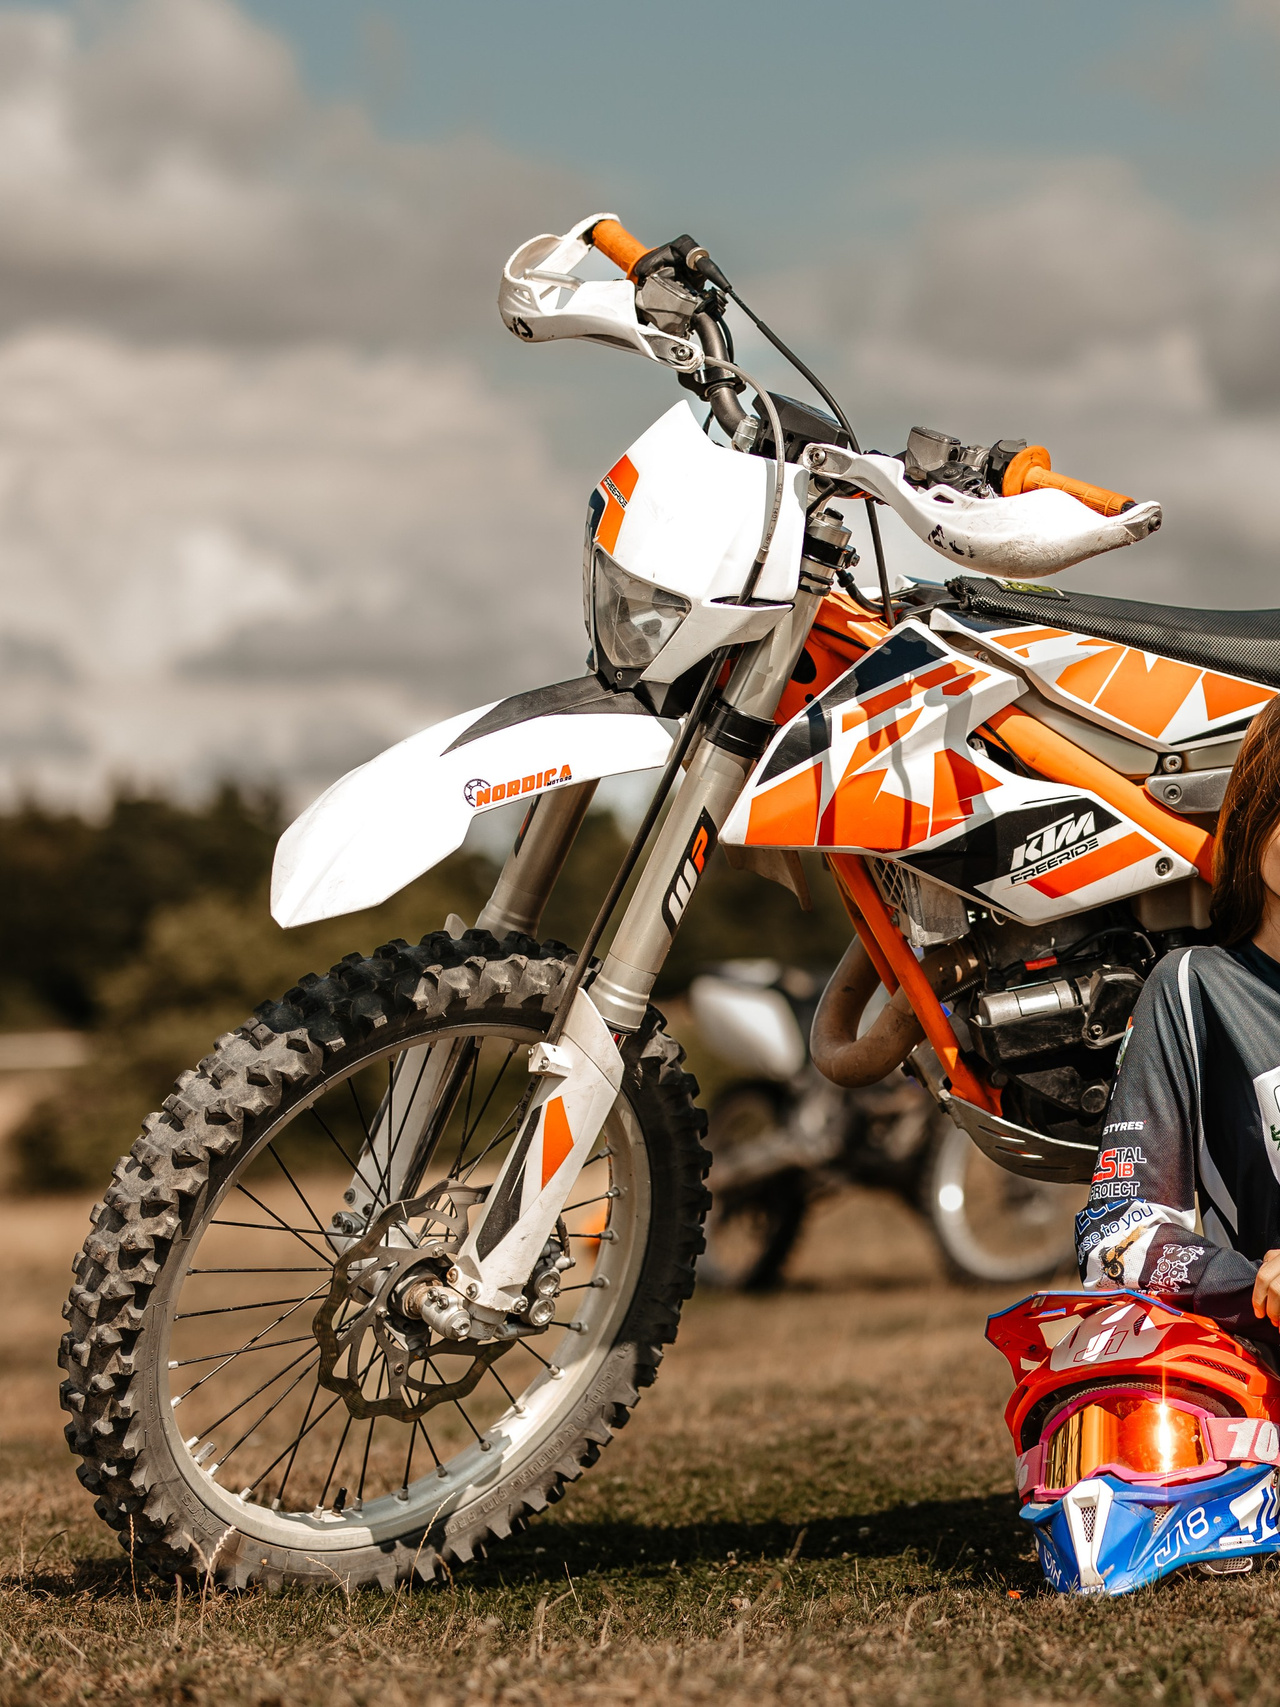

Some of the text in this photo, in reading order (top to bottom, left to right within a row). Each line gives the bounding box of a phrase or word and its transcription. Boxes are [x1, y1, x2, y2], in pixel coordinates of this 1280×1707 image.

[475, 764, 572, 808] NORDICA
[1010, 811, 1096, 871] KTM
[1011, 838, 1099, 885] FREERIDE
[1089, 1181, 1140, 1201] PROIECT
[1101, 1219, 1120, 1239] to
[1121, 1205, 1154, 1231] you
